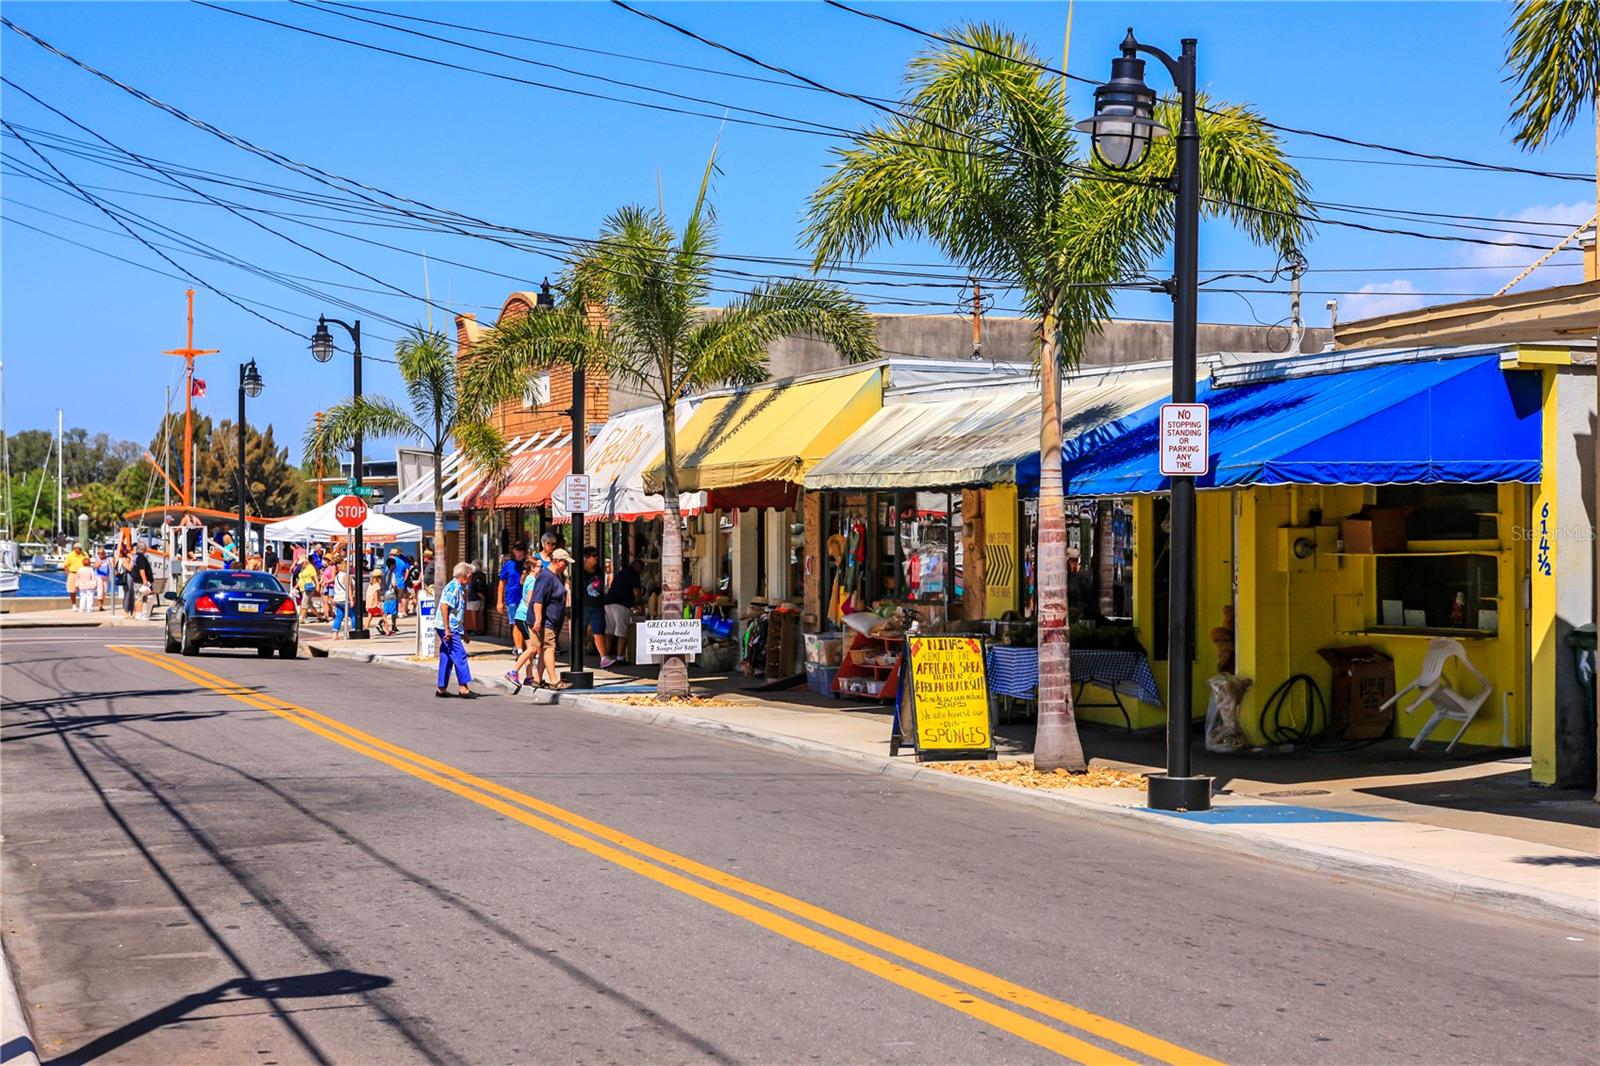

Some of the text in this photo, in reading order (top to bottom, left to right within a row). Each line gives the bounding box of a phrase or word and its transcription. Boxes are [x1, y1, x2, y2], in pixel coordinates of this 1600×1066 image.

[1177, 410, 1191, 420] NO
[1179, 437, 1189, 445] OR
[336, 505, 366, 518] STOP
[646, 620, 700, 629] GRECIAN SOAPS
[916, 662, 955, 674] AFRICAN
[921, 726, 987, 746] SPONGES
